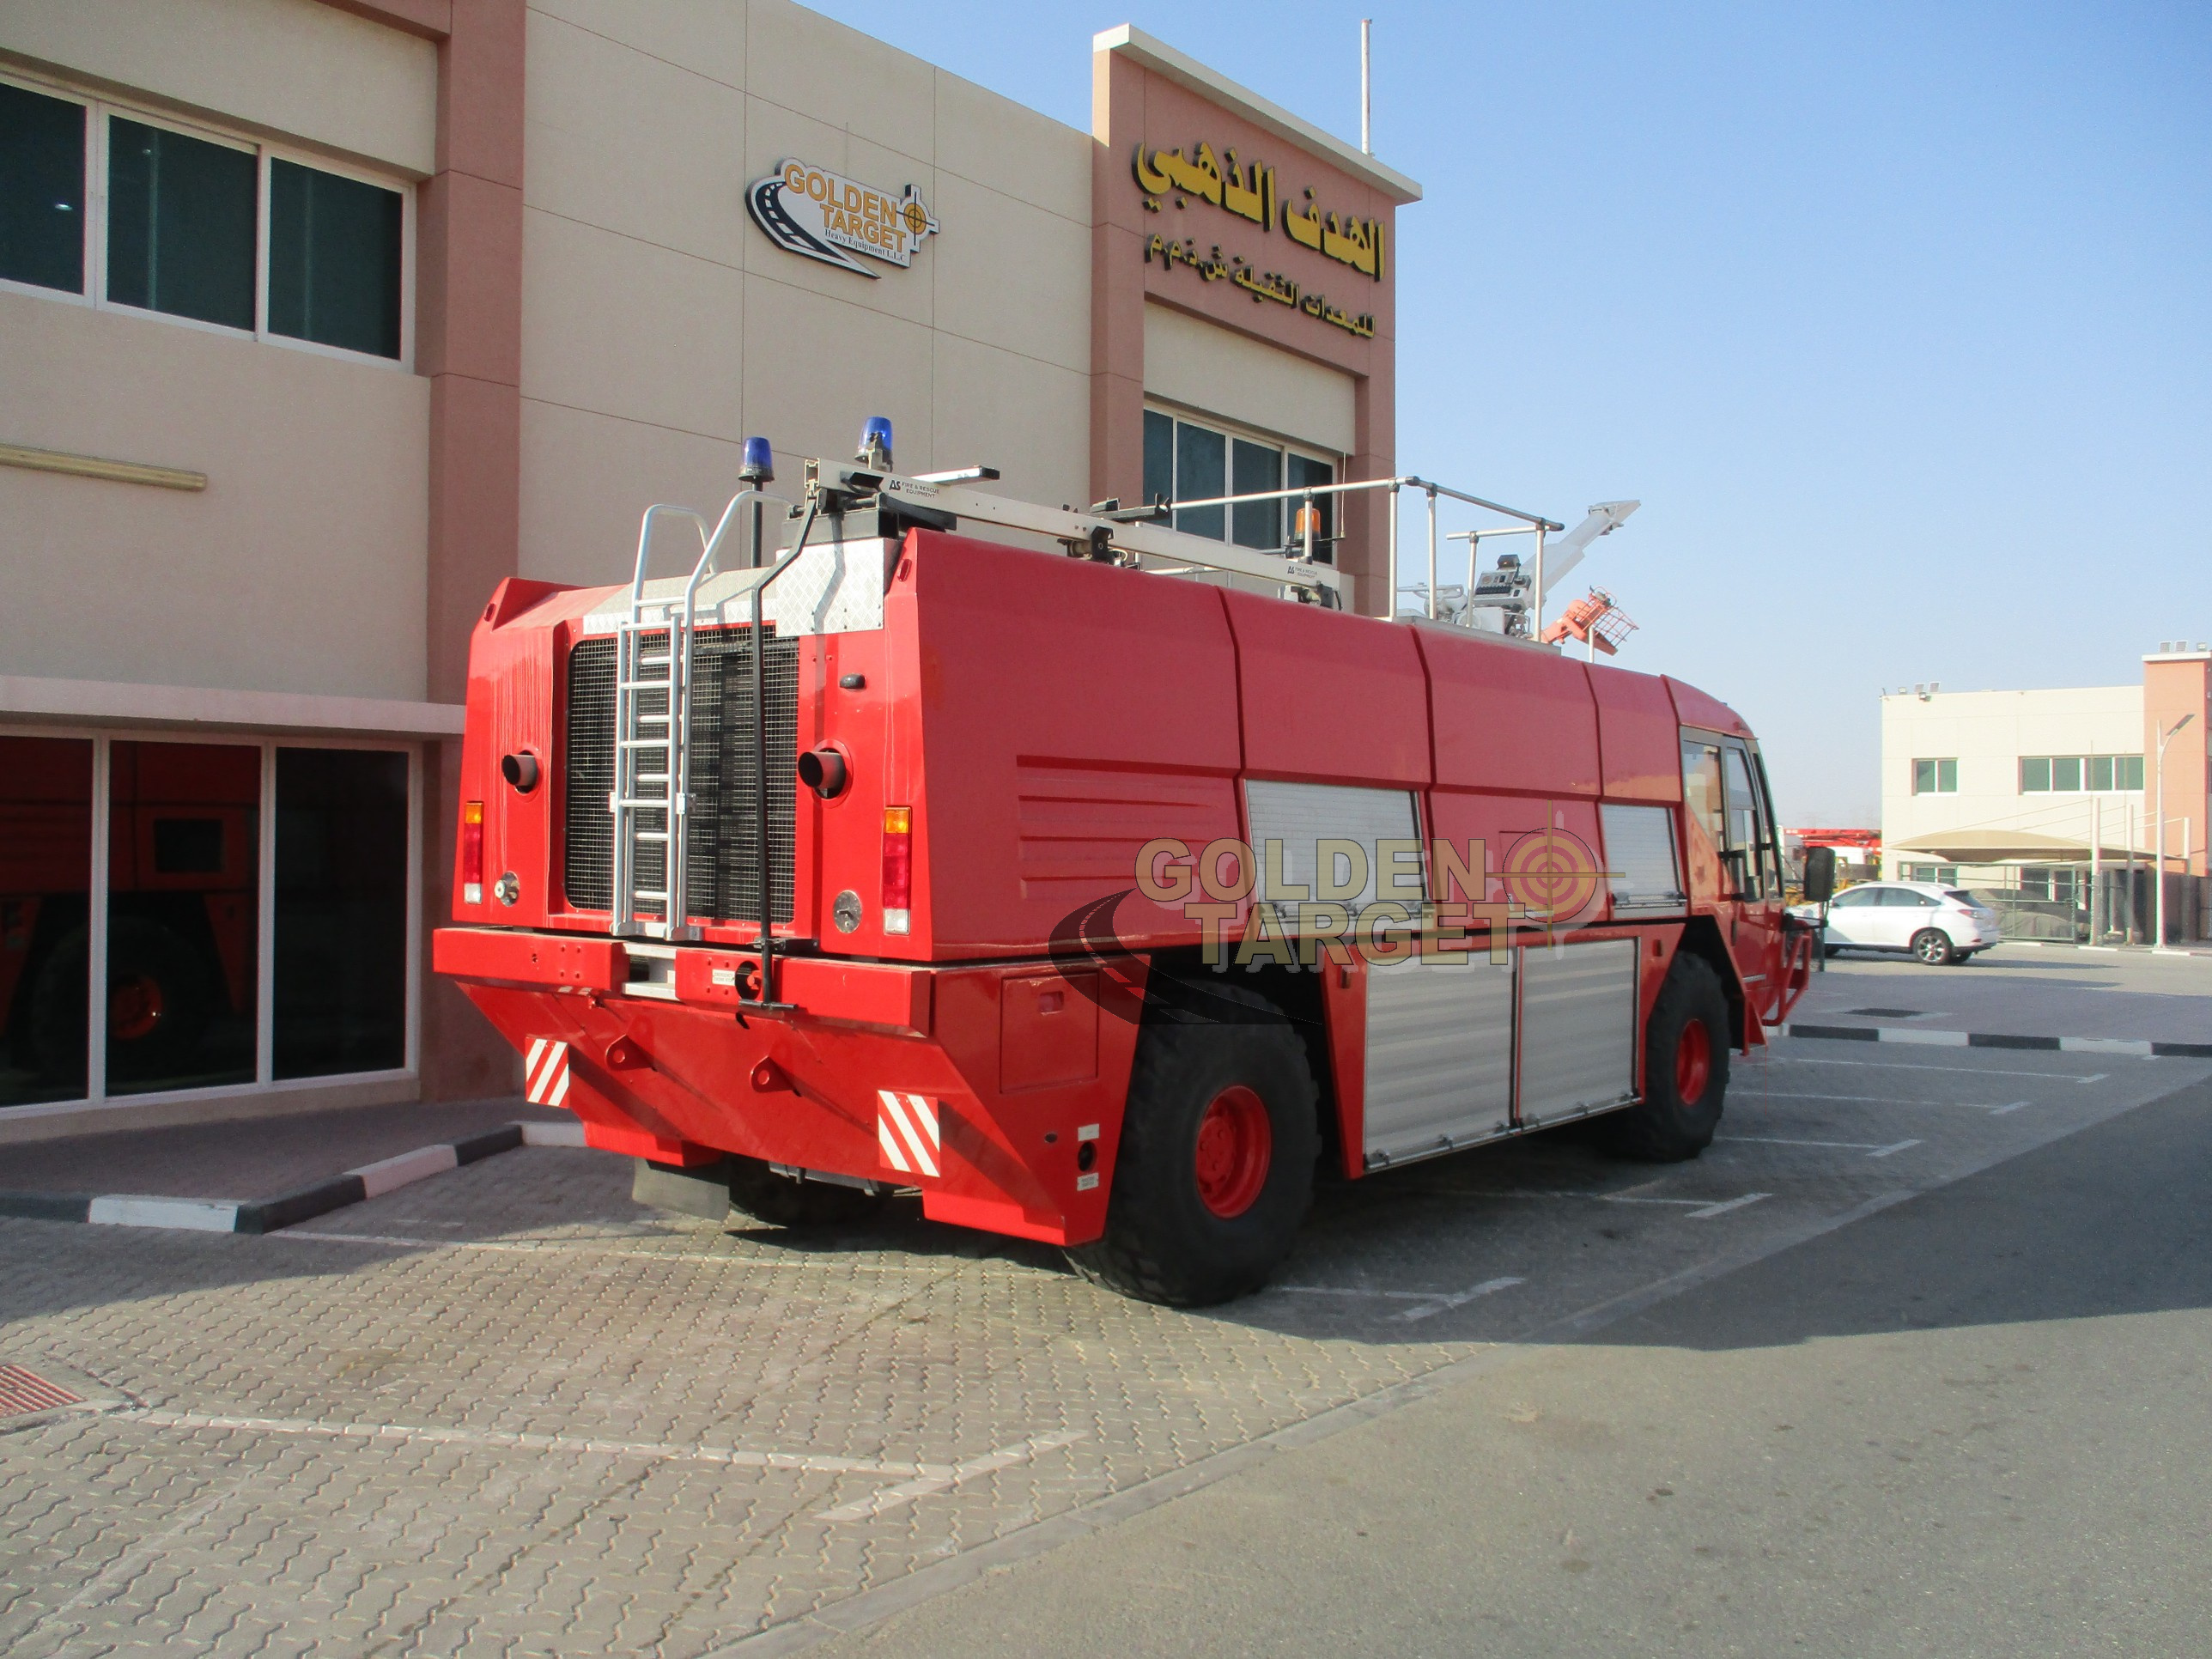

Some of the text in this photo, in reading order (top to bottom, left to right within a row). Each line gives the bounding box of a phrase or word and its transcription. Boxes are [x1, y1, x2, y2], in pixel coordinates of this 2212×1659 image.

[784, 163, 897, 228] GOLDEN
[1132, 141, 1385, 282] الهدف الذهبي
[819, 204, 907, 252] TARGET
[825, 228, 846, 244] Heavy
[848, 237, 885, 256] Equipment
[1301, 294, 1375, 338] للمعدات
[906, 488, 936, 498] EQUIPMENT
[919, 484, 940, 495] RESCUE
